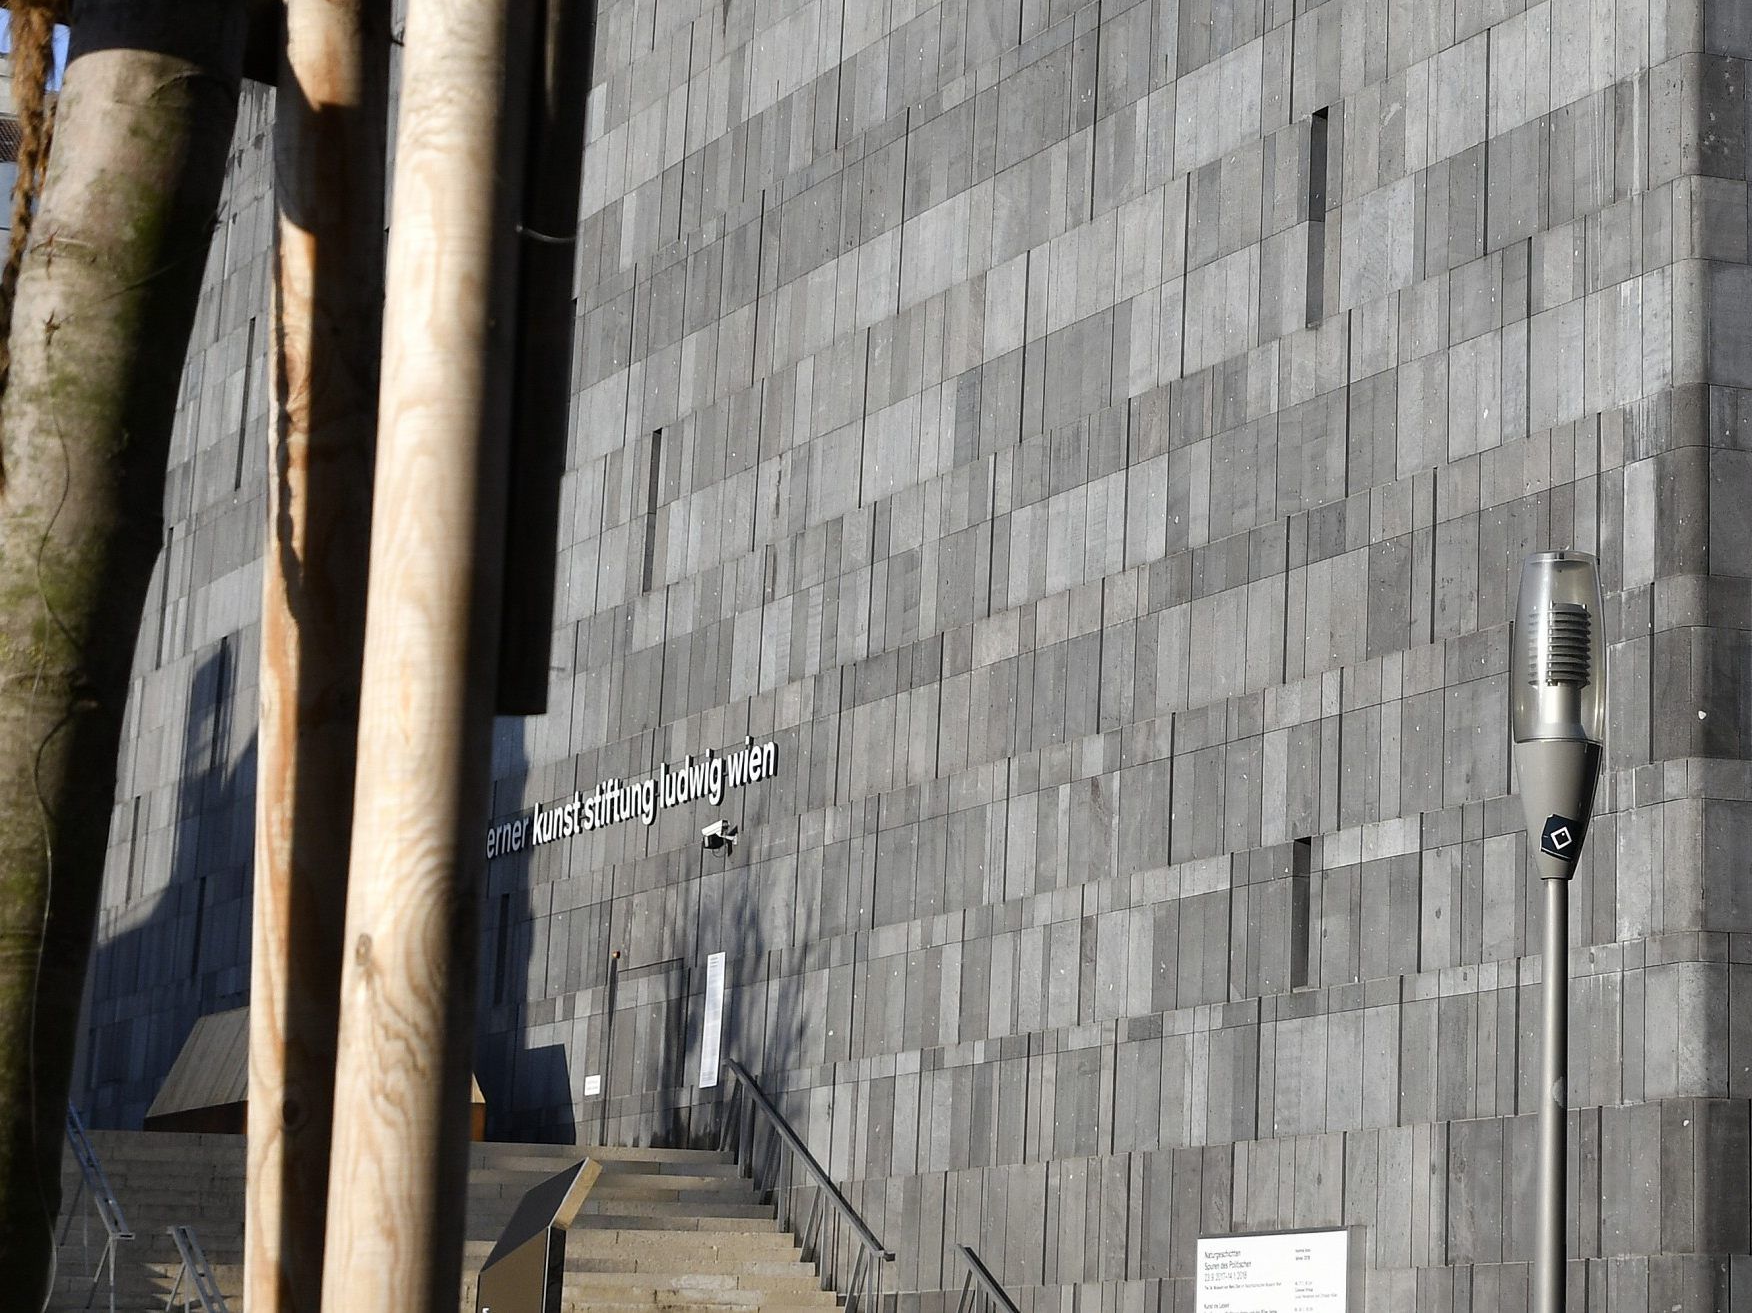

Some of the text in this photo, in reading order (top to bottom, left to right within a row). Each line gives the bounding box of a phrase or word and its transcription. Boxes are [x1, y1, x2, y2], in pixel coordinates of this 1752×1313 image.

[486, 736, 778, 859] erner kunst stiftung ludwig wien
